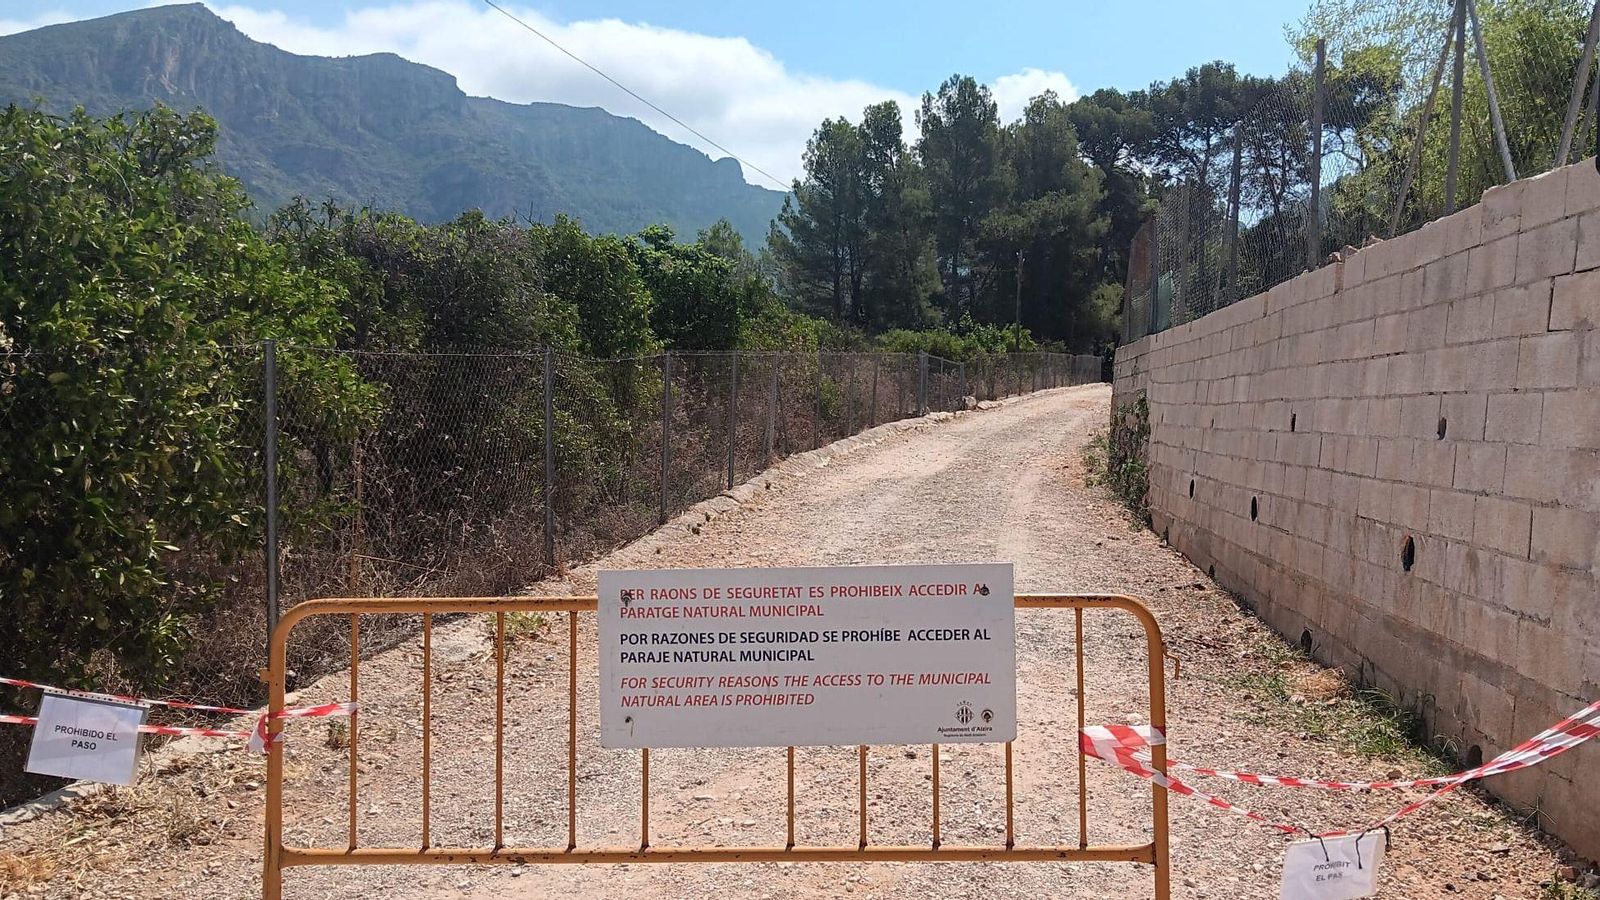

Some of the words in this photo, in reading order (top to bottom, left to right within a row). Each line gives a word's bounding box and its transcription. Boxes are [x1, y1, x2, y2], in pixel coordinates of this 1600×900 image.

[650, 588, 697, 600] RAONS
[703, 587, 721, 599] DE
[727, 587, 803, 599] SEGURETAT
[809, 586, 824, 598] ES
[830, 585, 902, 597] PROHIBEIX
[909, 584, 967, 596] ACCEDIR
[973, 584, 990, 596] A
[620, 606, 679, 619] PARATGE
[683, 605, 745, 618] NATURAL
[750, 604, 824, 617] MUNICIPAL
[620, 633, 648, 645] POR
[651, 632, 715, 645] RAZONES
[719, 632, 736, 644] DE
[740, 631, 819, 644] SEGURIDAD
[823, 630, 838, 642] SE
[842, 628, 901, 642] PROHÍBE
[908, 629, 970, 641] ACCEDER
[973, 628, 991, 641] AL
[620, 651, 670, 663] PARAJE
[673, 650, 736, 663] NATURAL
[740, 650, 815, 662] MUNICIPAL
[620, 677, 647, 689] FOR
[651, 676, 714, 689] SECURITY
[718, 675, 779, 688] REASONS
[784, 675, 809, 687] THE
[813, 674, 862, 687] ACCESS
[867, 674, 884, 686] TO
[889, 673, 914, 685] THE
[918, 673, 991, 685] MUNICIPAL
[621, 695, 681, 707] NATURAL
[684, 694, 718, 707] AREA
[721, 694, 733, 706] IS
[736, 693, 815, 706] PROHIBITED
[54, 725, 104, 739] PROHIBIDO
[106, 732, 118, 741] EL
[71, 740, 97, 750] PASO
[1316, 874, 1326, 882] EL
